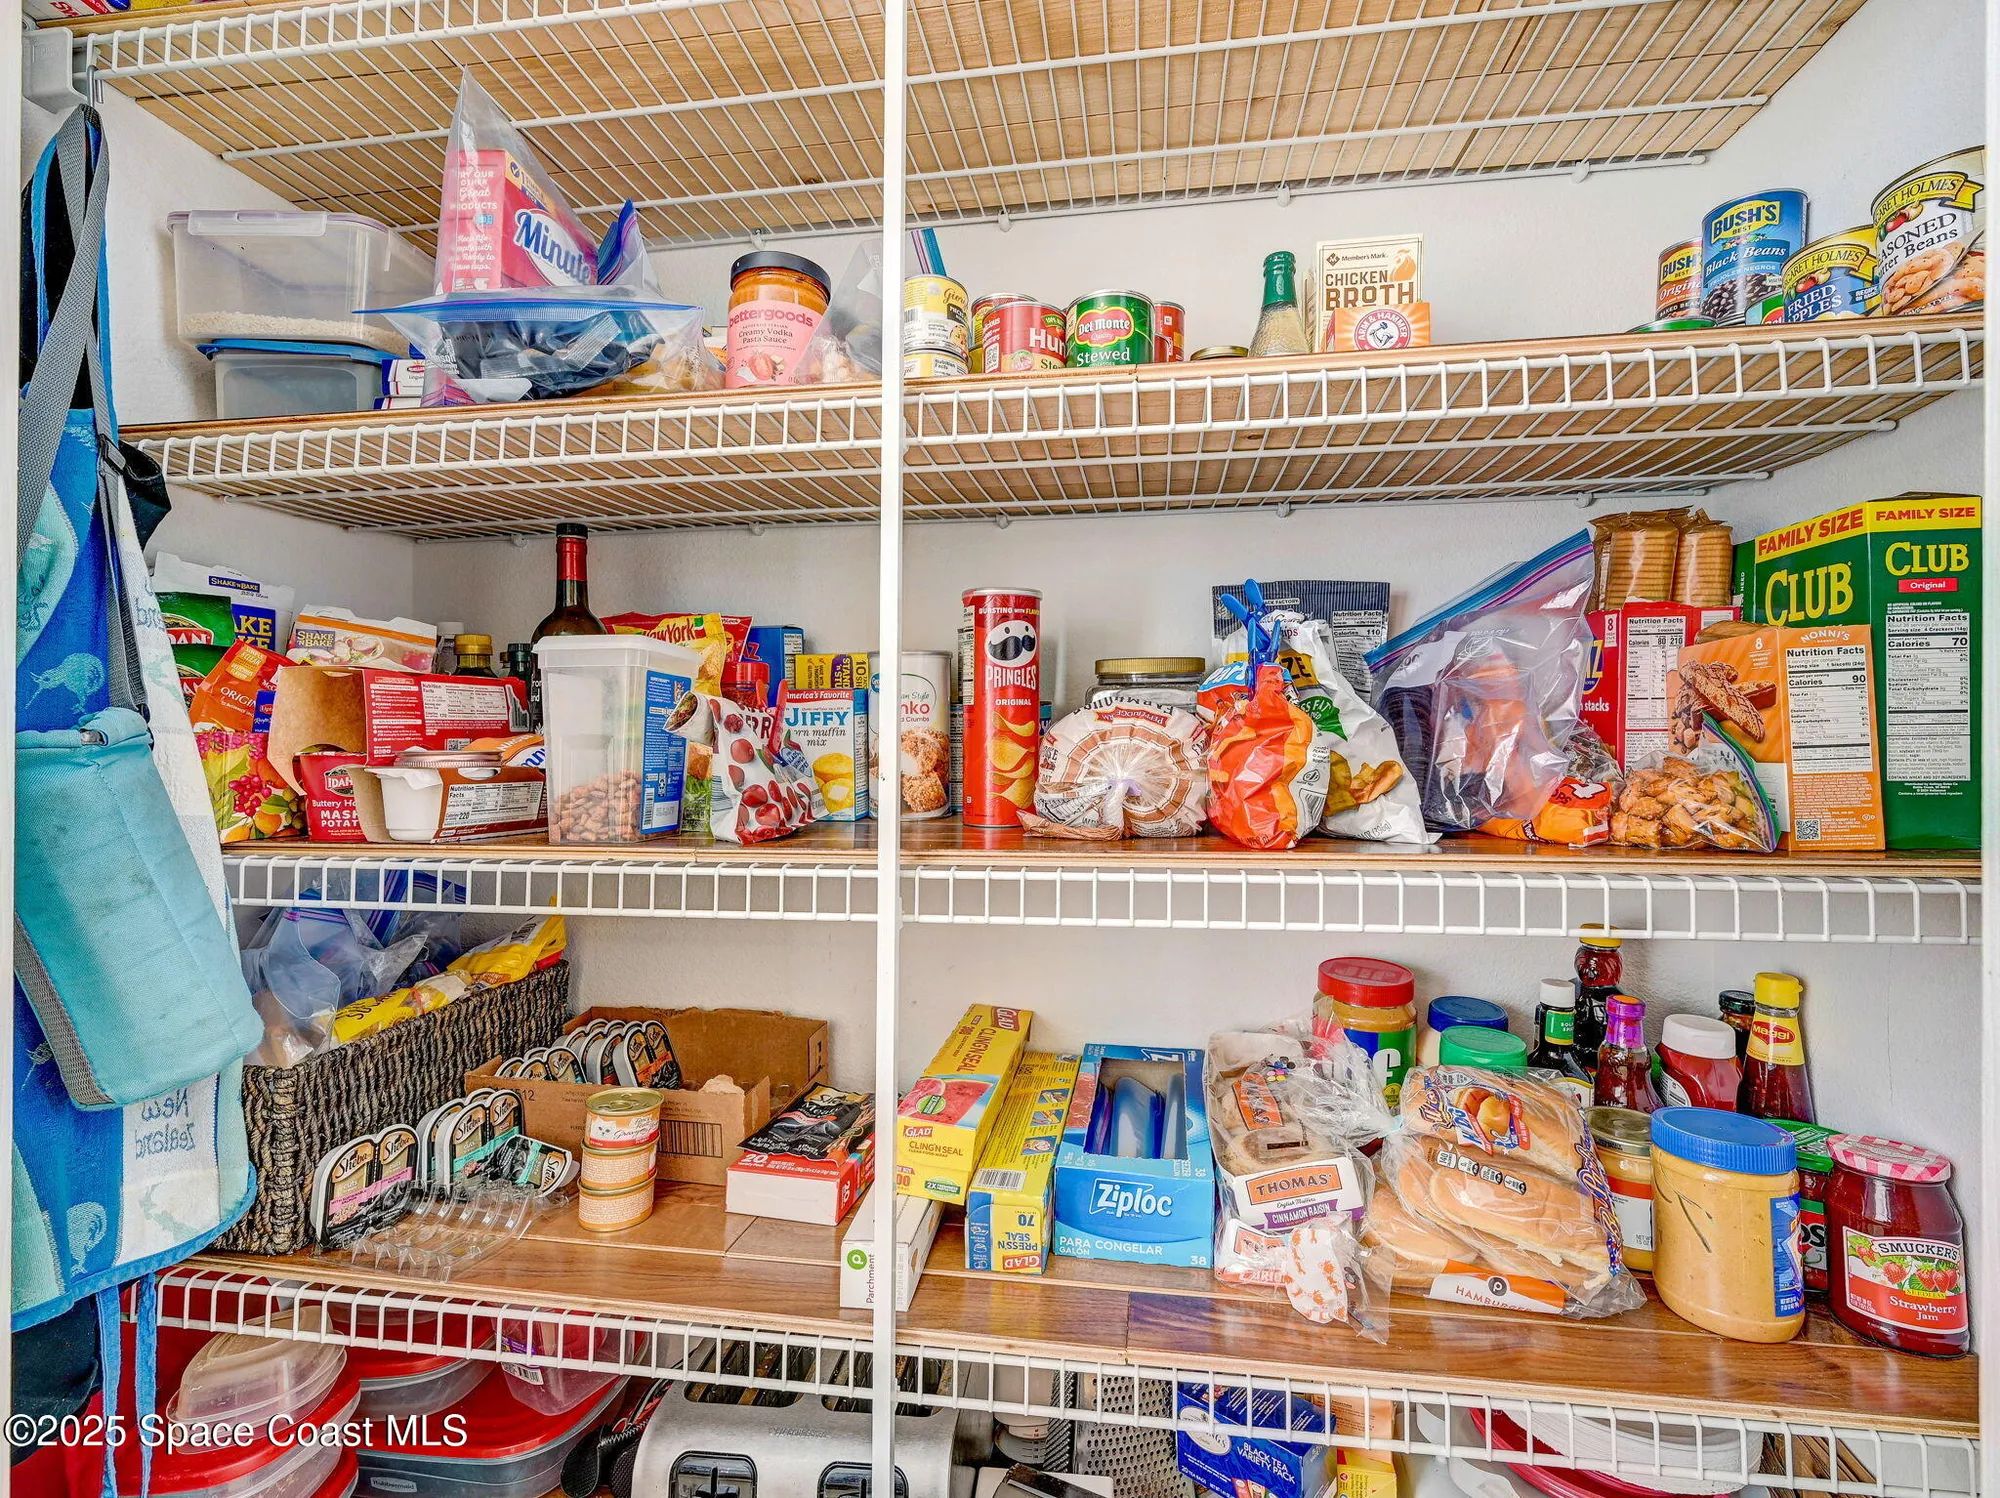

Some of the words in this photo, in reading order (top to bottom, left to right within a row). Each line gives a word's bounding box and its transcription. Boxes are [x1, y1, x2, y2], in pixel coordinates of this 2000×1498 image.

[474, 170, 495, 178] OUR
[1712, 203, 1779, 240] BUSH'S
[1732, 225, 1753, 236] BEST
[514, 210, 591, 284] Minute
[1904, 228, 1959, 259] Beans
[1342, 253, 1370, 263] Member's
[1704, 252, 1739, 279] Black
[1743, 244, 1787, 259] Beans
[1674, 269, 1690, 279] BEST
[1743, 264, 1777, 272] NEGROS
[1325, 269, 1389, 287] CHICKEN
[1325, 281, 1415, 312] BROTH
[1787, 284, 1837, 317] FRIED
[729, 307, 815, 330] bettergoods
[738, 327, 766, 339] Creamy
[767, 327, 794, 338] Vodka
[1078, 323, 1094, 335] Del
[1095, 318, 1131, 331] Monte
[1357, 321, 1371, 341] ARM
[1376, 312, 1409, 339] HAMMER
[742, 336, 762, 345] Pasta
[763, 335, 788, 345] Sauce
[1076, 347, 1131, 367] Stewed
[1875, 508, 1936, 521] FAMILY
[1938, 506, 1976, 519] SIZE
[1757, 520, 1816, 557] FAMILY
[1818, 507, 1865, 539] SIZE
[1885, 541, 1970, 576] CLUB
[1909, 581, 1946, 592] Original
[1764, 562, 1855, 627] CLUB
[978, 607, 1013, 615] BURSTING
[1607, 618, 1614, 631] 8
[1887, 615, 1935, 623] Nutrition
[296, 630, 335, 644] SHAKE
[1657, 637, 1667, 645] 80
[1669, 637, 1683, 645] 210
[1800, 629, 1851, 643] NONNI'S
[1888, 640, 1931, 648] Calories
[1951, 637, 1968, 646] 70
[305, 639, 334, 648] BAKE
[1755, 637, 1763, 650] 8
[1786, 648, 1834, 658] Nutrition
[1837, 646, 1865, 656] Facts
[842, 657, 851, 689] STAND
[984, 663, 1037, 691] PRINGLES
[1788, 679, 1823, 687] Calories
[1852, 674, 1866, 683] 90
[220, 686, 256, 708] ORIGIN
[819, 691, 850, 700] Favorite
[911, 691, 930, 700] Style
[995, 698, 1032, 706] ORIGINAL
[1585, 697, 1610, 712] stacks
[812, 728, 847, 737] muffin
[806, 738, 828, 747] mix
[312, 799, 341, 809] Buttery
[458, 812, 470, 820] 220
[996, 1007, 1017, 1030] GLAD
[1752, 1024, 1790, 1040] Maggi
[904, 1128, 932, 1137] GLAD
[740, 1153, 768, 1163] 20
[941, 1146, 964, 1156] SEAL
[335, 1149, 369, 1179] Sheba
[1097, 1182, 1173, 1218] Ziploc
[1018, 1213, 1036, 1227] 70
[1271, 1208, 1307, 1224] CINNAMON
[1307, 1202, 1332, 1217] RAISIN
[1004, 1231, 1031, 1242] SEAL
[1059, 1236, 1092, 1248] PARA
[1095, 1240, 1163, 1256] CONGELAR
[1059, 1245, 1090, 1257] GALÓN
[1877, 1242, 1960, 1262] SMUCKER'S
[1004, 1255, 1040, 1269] GLAD
[1190, 1255, 1207, 1266] 38
[866, 1253, 875, 1304] Parchment
[1889, 1295, 1958, 1316] Strawberry
[1916, 1312, 1939, 1322] Jam
[1243, 1441, 1270, 1463] BLACK
[1271, 1456, 1288, 1472] TEA
[1236, 1446, 1272, 1471] VARIETY
[1272, 1466, 1296, 1485] PACK
[372, 1479, 416, 1491] Rubbermaid
